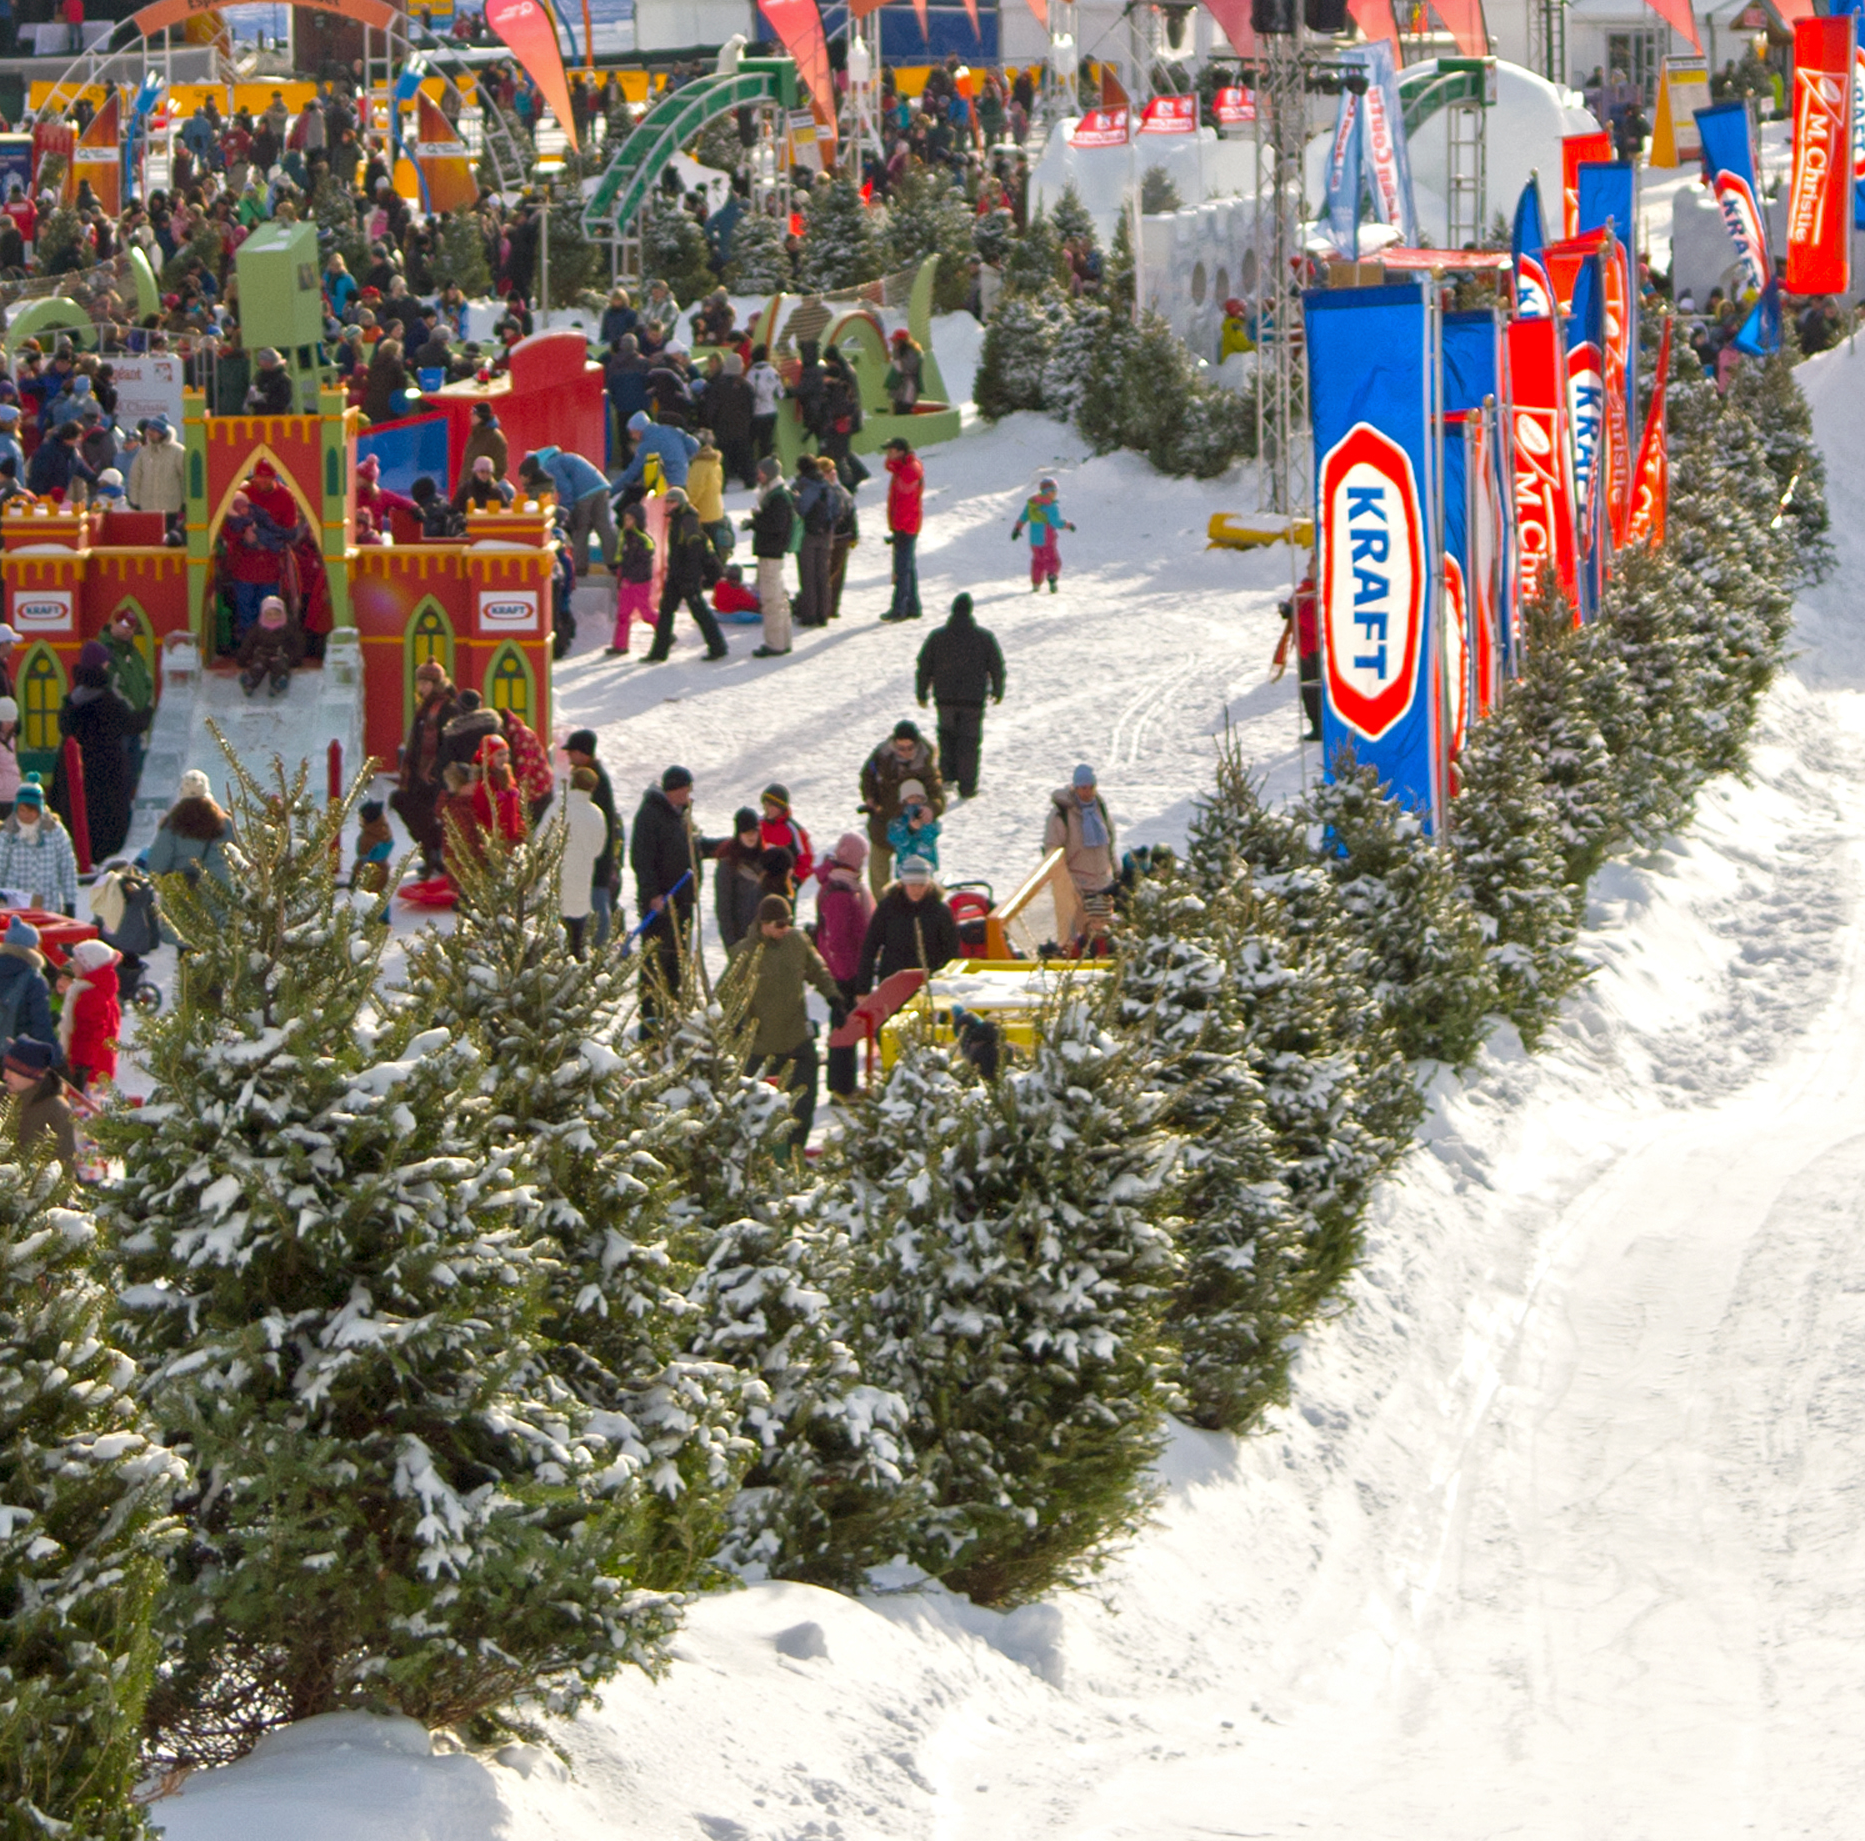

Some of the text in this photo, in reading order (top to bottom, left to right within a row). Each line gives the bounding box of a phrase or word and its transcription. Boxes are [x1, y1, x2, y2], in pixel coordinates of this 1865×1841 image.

[1723, 199, 1761, 289] KRAFT
[1347, 487, 1390, 680] KRAFT
[26, 605, 60, 615] KRAFT
[491, 605, 525, 615] KRAFT
